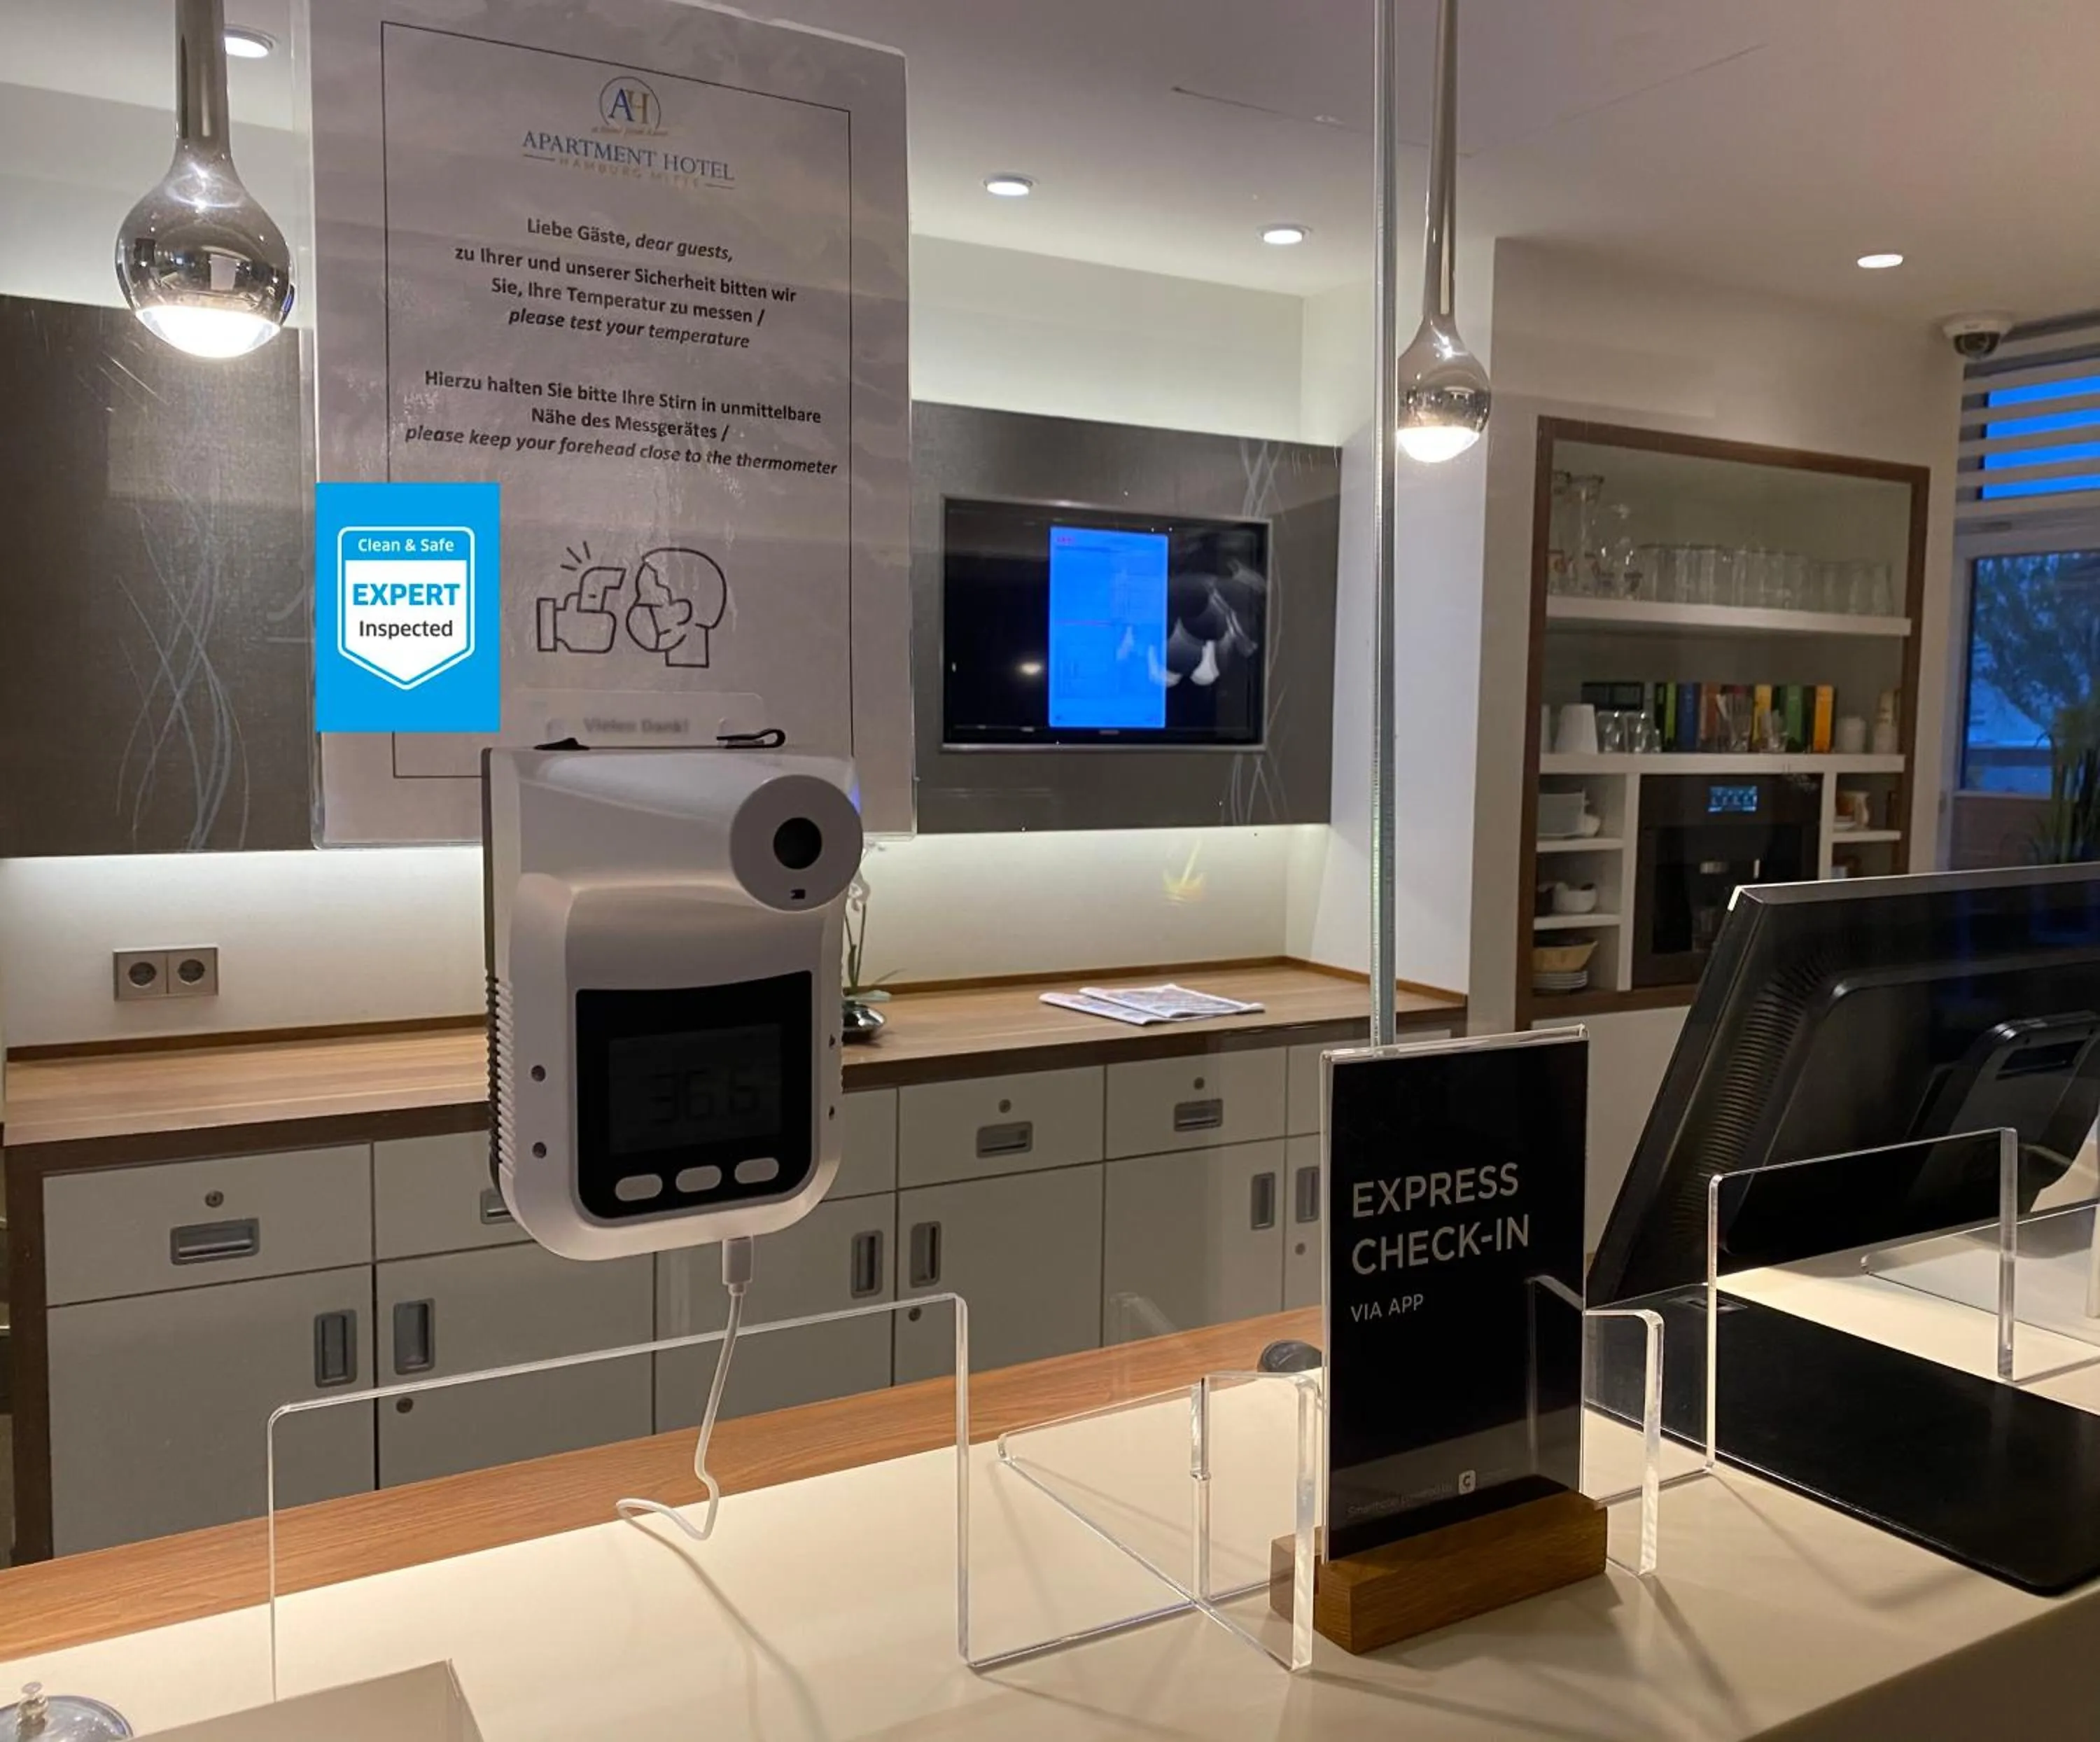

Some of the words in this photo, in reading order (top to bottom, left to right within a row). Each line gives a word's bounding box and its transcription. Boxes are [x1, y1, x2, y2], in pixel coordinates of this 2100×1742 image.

[522, 131, 657, 167] APARTMENT
[664, 153, 734, 181] HOTEL
[559, 158, 642, 179] HAMBURG
[526, 218, 572, 239] Liebe
[578, 225, 630, 249] Gäste,
[635, 235, 673, 252] dear
[678, 242, 733, 262] guests,
[454, 248, 475, 262] zu
[480, 248, 523, 268] Ihrer
[528, 256, 560, 272] und
[566, 263, 630, 281] unserer
[634, 268, 715, 293] Sicherheit
[720, 279, 767, 299] bitten
[771, 288, 797, 302] wir
[492, 278, 523, 298] Sie,
[528, 282, 561, 300] Ihre
[567, 288, 665, 313] Temperatur
[669, 302, 688, 316] zu
[693, 304, 752, 323] messen
[508, 308, 564, 328] please
[570, 316, 601, 332] test
[606, 320, 645, 336] your
[648, 325, 750, 349] temperature
[425, 370, 482, 390] Hierzu
[487, 376, 542, 396] halten
[547, 382, 572, 398] Sie
[578, 385, 617, 403] bitte
[622, 389, 654, 407] Ihre
[659, 393, 696, 411] Stirn
[701, 397, 716, 412] in
[720, 402, 821, 424] unmittelbare
[531, 407, 576, 426] Nähe
[581, 412, 610, 429] des
[615, 415, 718, 440] Messgerätes
[405, 425, 464, 444] please
[468, 429, 511, 450] keep
[515, 436, 556, 451] your
[557, 437, 636, 457] forehead
[640, 445, 680, 461] close
[685, 450, 701, 463] to
[706, 450, 732, 466] the
[736, 453, 837, 475] thermometer
[1352, 1162, 1519, 1218] EXPRESS
[1352, 1213, 1530, 1275] CHECK-IN
[1350, 1301, 1383, 1323] VIA
[1388, 1293, 1424, 1316] APP
